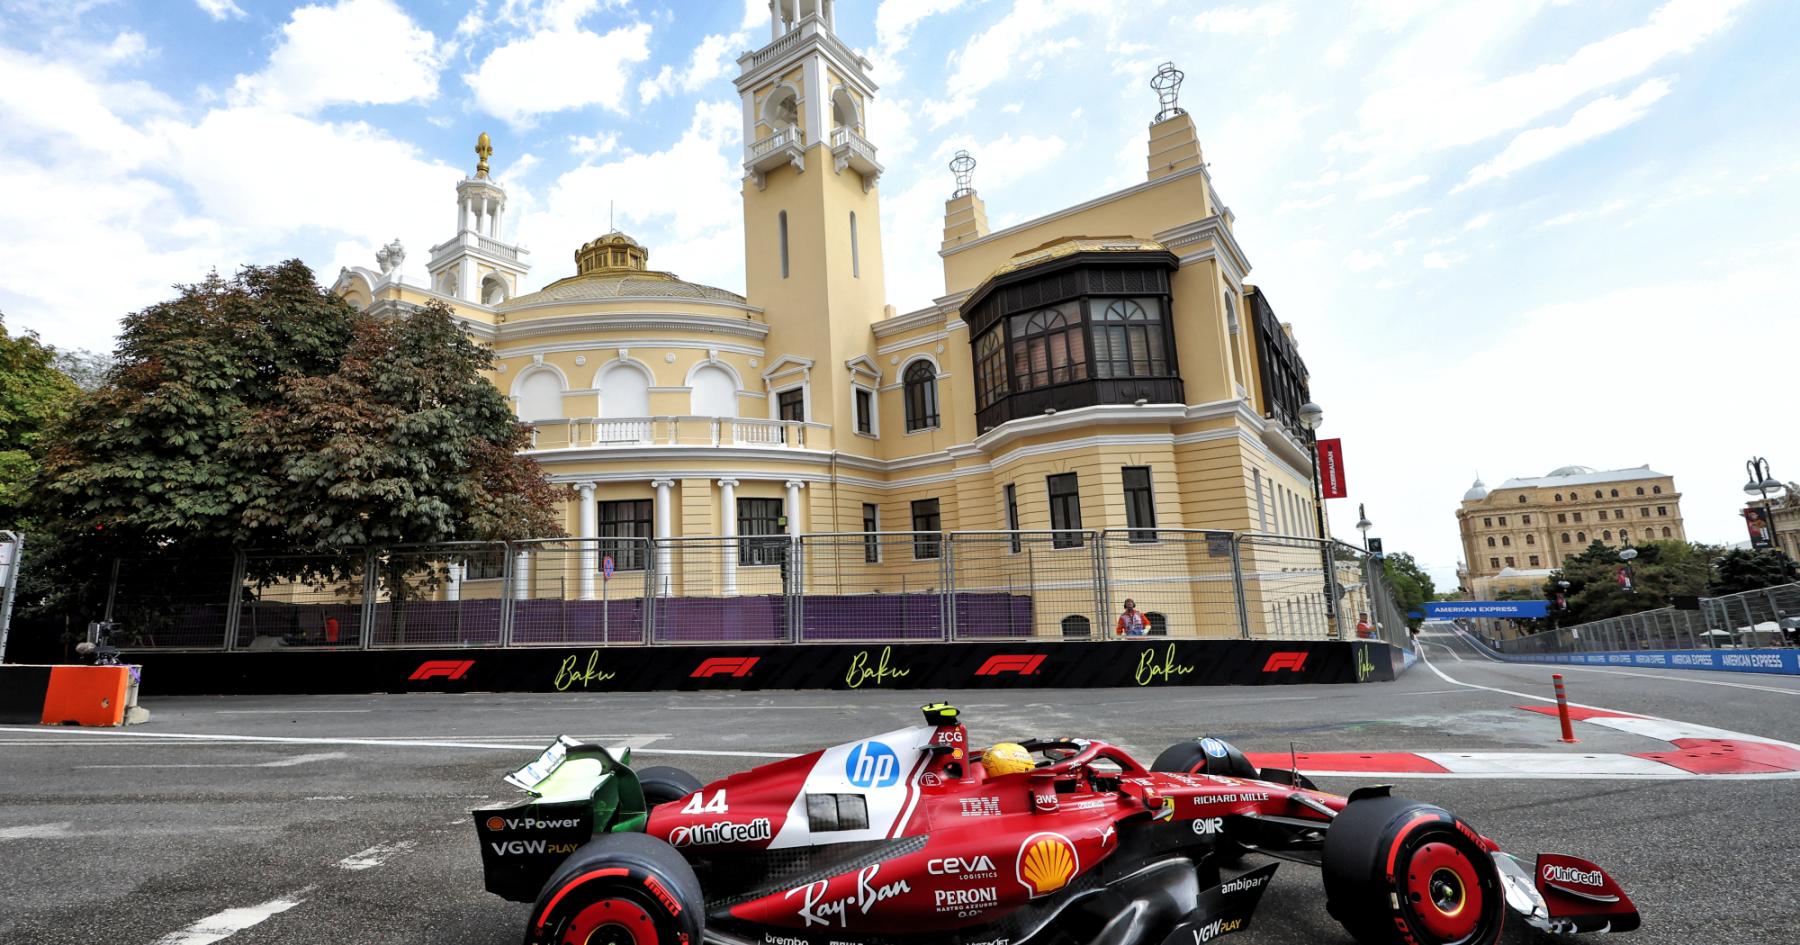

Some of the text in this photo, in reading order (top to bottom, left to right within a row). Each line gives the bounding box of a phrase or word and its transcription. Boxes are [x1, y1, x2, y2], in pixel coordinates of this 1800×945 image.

[554, 650, 616, 691] Baku
[846, 646, 910, 688] Baku
[1135, 643, 1194, 686] Baku
[1722, 654, 1782, 668] AMERICAN EXPRESS
[852, 742, 895, 790] hp
[680, 788, 728, 814] 44
[960, 797, 1001, 816] IBM
[1036, 794, 1058, 804] aws
[1193, 792, 1269, 805] RICHARD MILLE
[506, 818, 580, 830] V-Power
[691, 818, 770, 845] UniCredit
[491, 840, 578, 856] VGW PLAY
[959, 872, 998, 880] LOGISTICS
[1554, 866, 1603, 886] UniCredit
[1222, 878, 1262, 894] ambipar
[934, 887, 997, 906] PERONI
[1192, 919, 1241, 945] VGW PLAY
